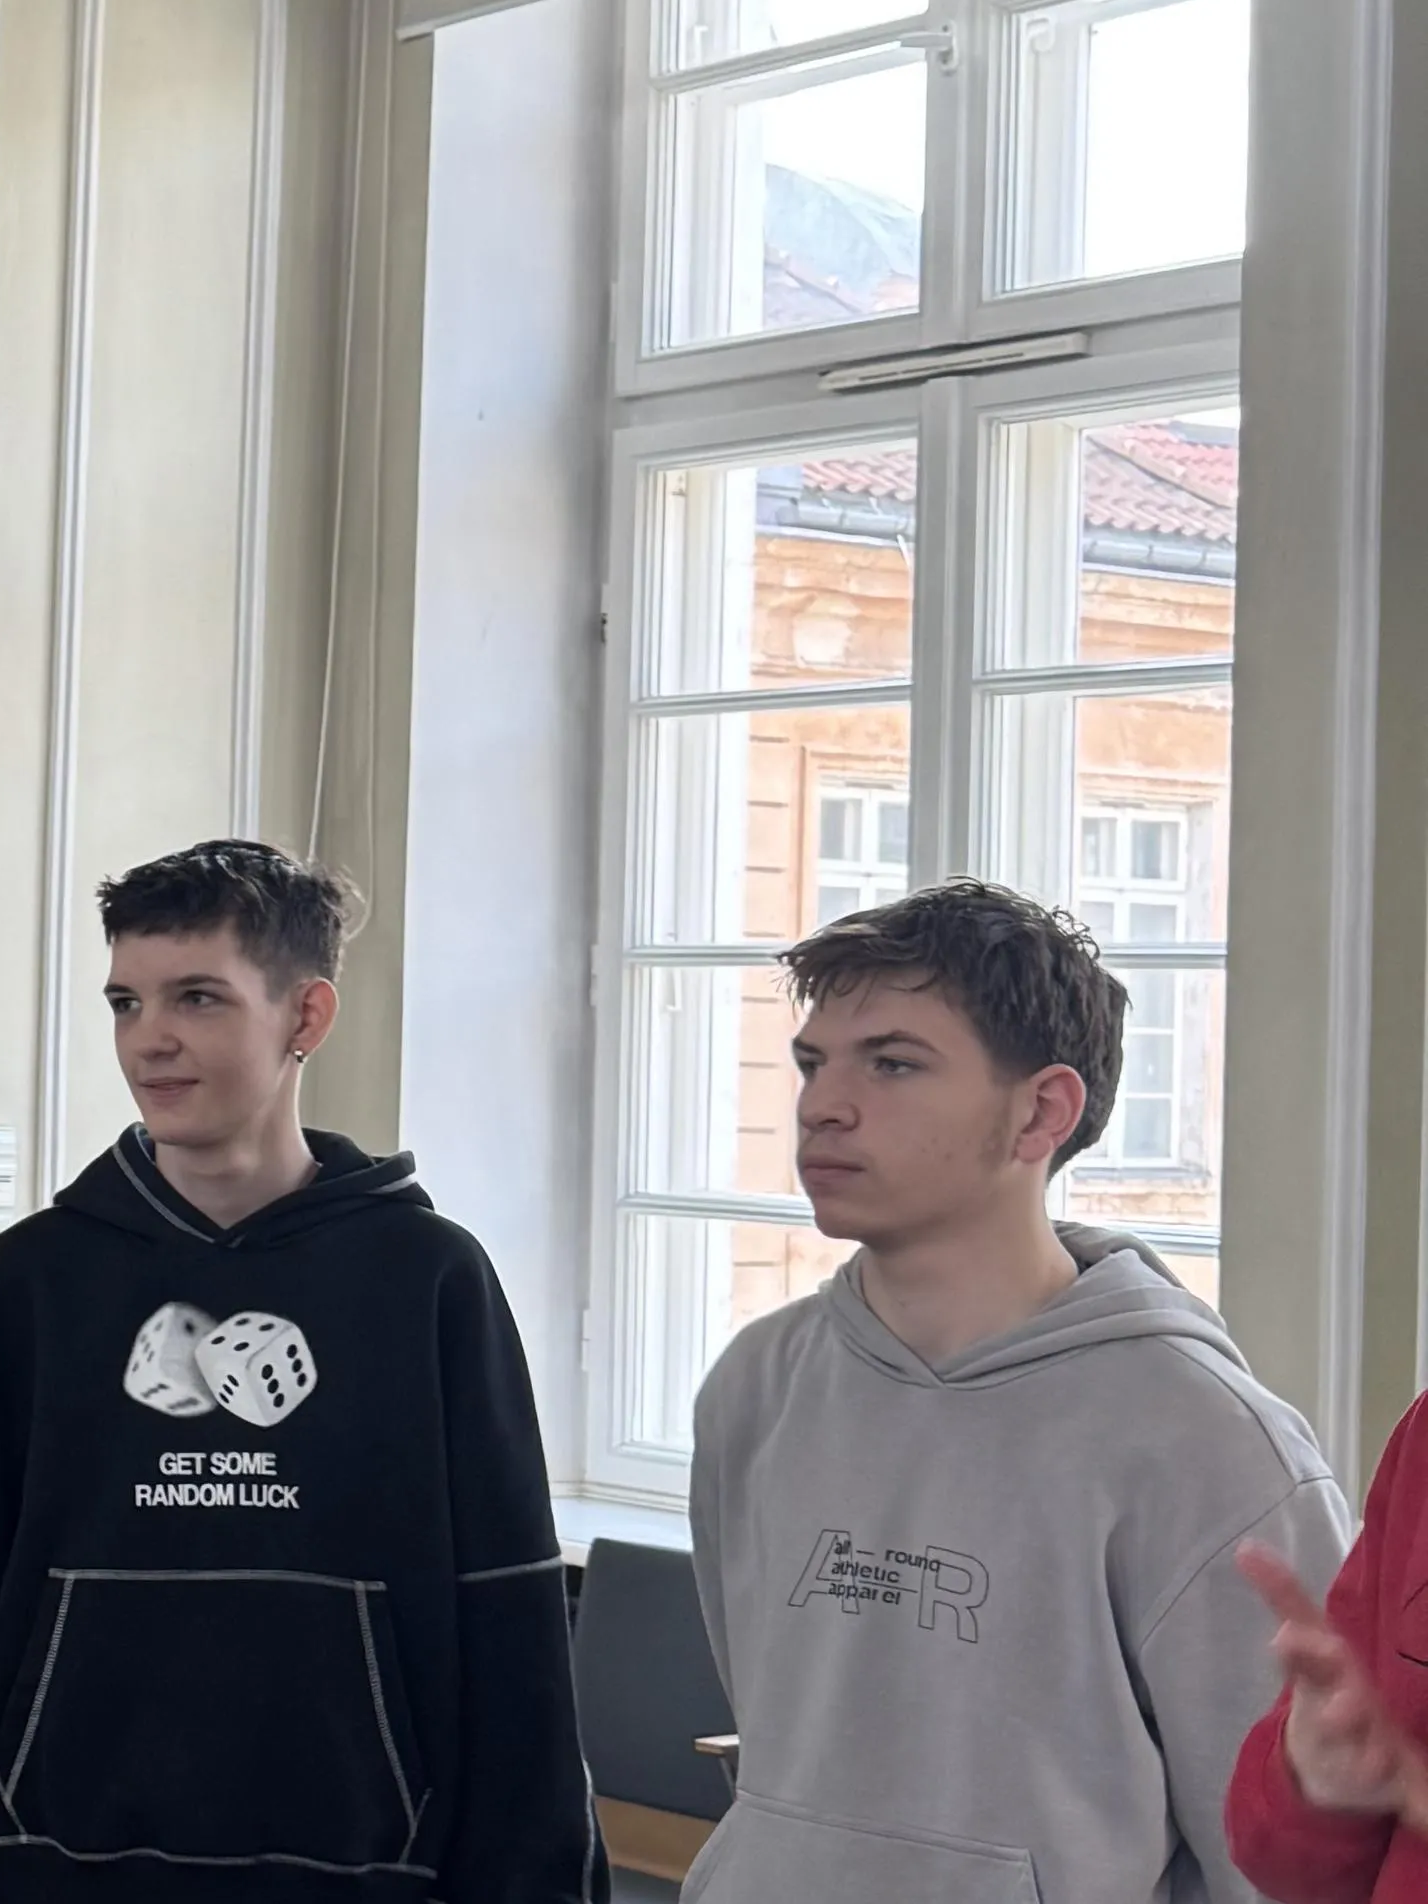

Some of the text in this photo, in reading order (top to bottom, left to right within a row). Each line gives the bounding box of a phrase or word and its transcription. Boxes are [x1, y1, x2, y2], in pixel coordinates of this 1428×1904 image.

[158, 1451, 278, 1476] GET SOME
[134, 1483, 300, 1509] RANDOM LUCK
[831, 1560, 901, 1584] athletic
[827, 1582, 903, 1606] apparel
